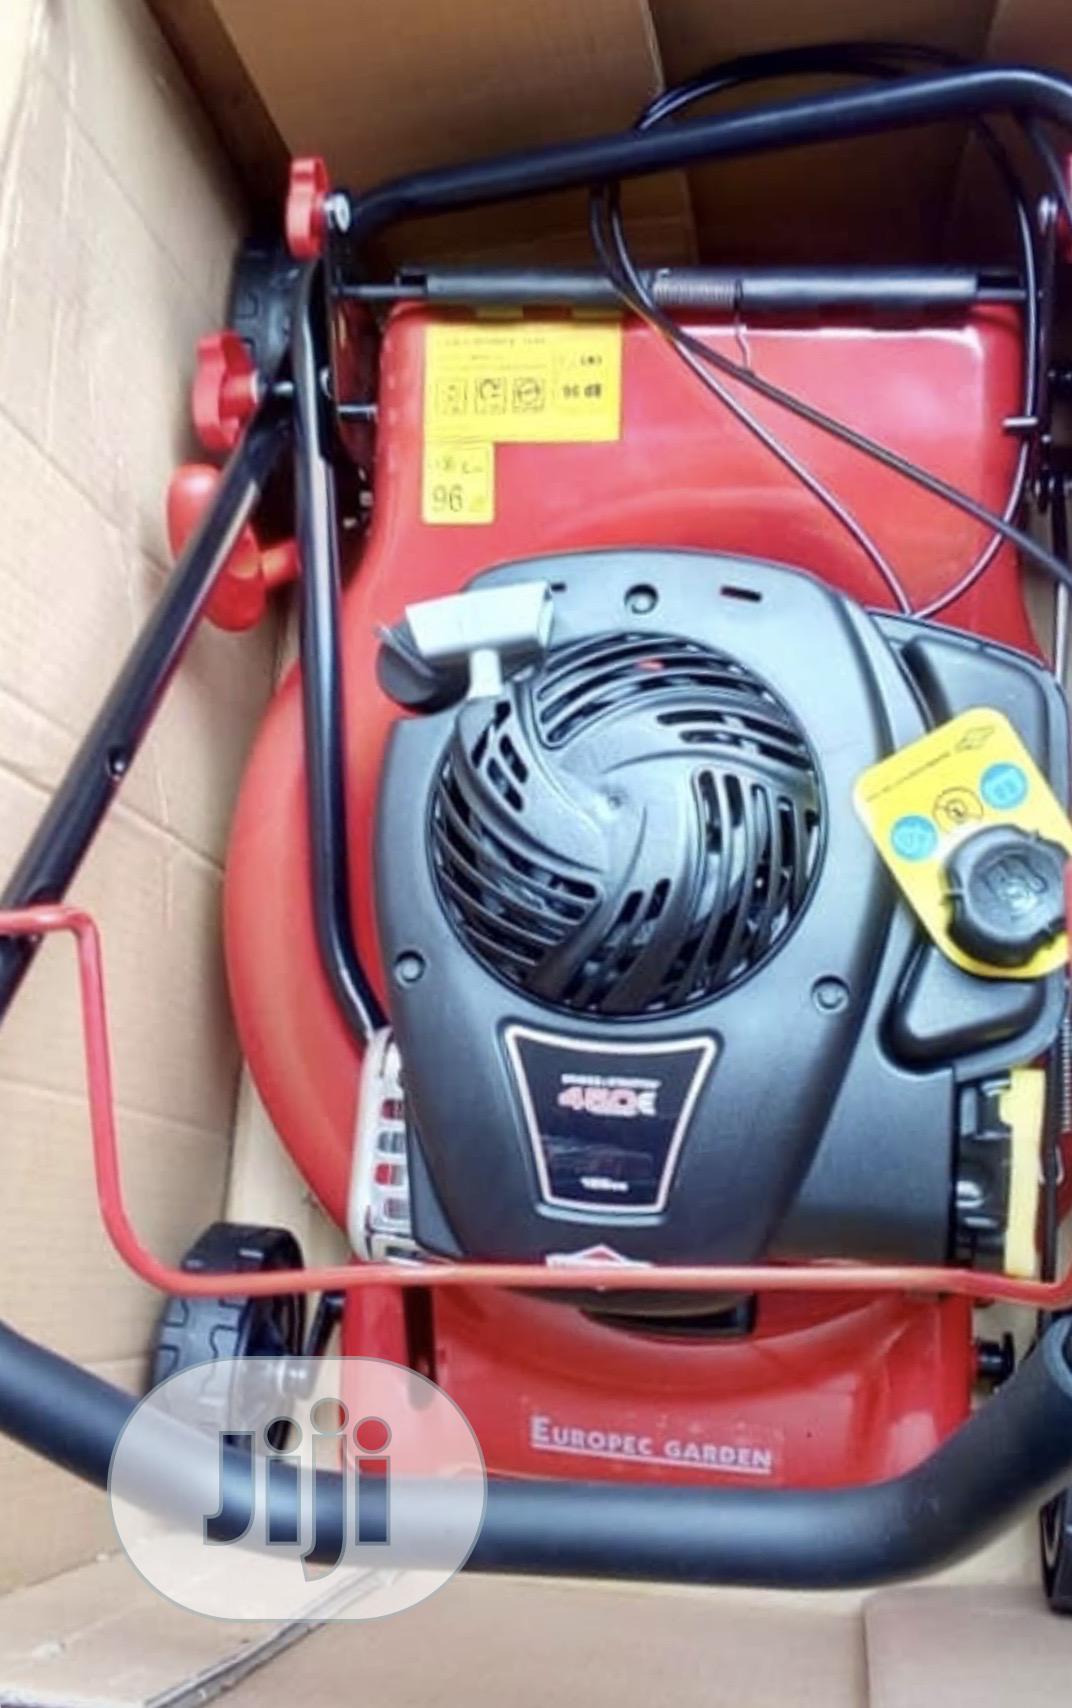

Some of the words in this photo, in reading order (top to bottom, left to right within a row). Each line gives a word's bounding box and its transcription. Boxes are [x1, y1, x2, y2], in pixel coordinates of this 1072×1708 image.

[432, 484, 463, 512] 96
[530, 1414, 654, 1456] EUROPEC
[663, 1439, 773, 1469] GARDEN
